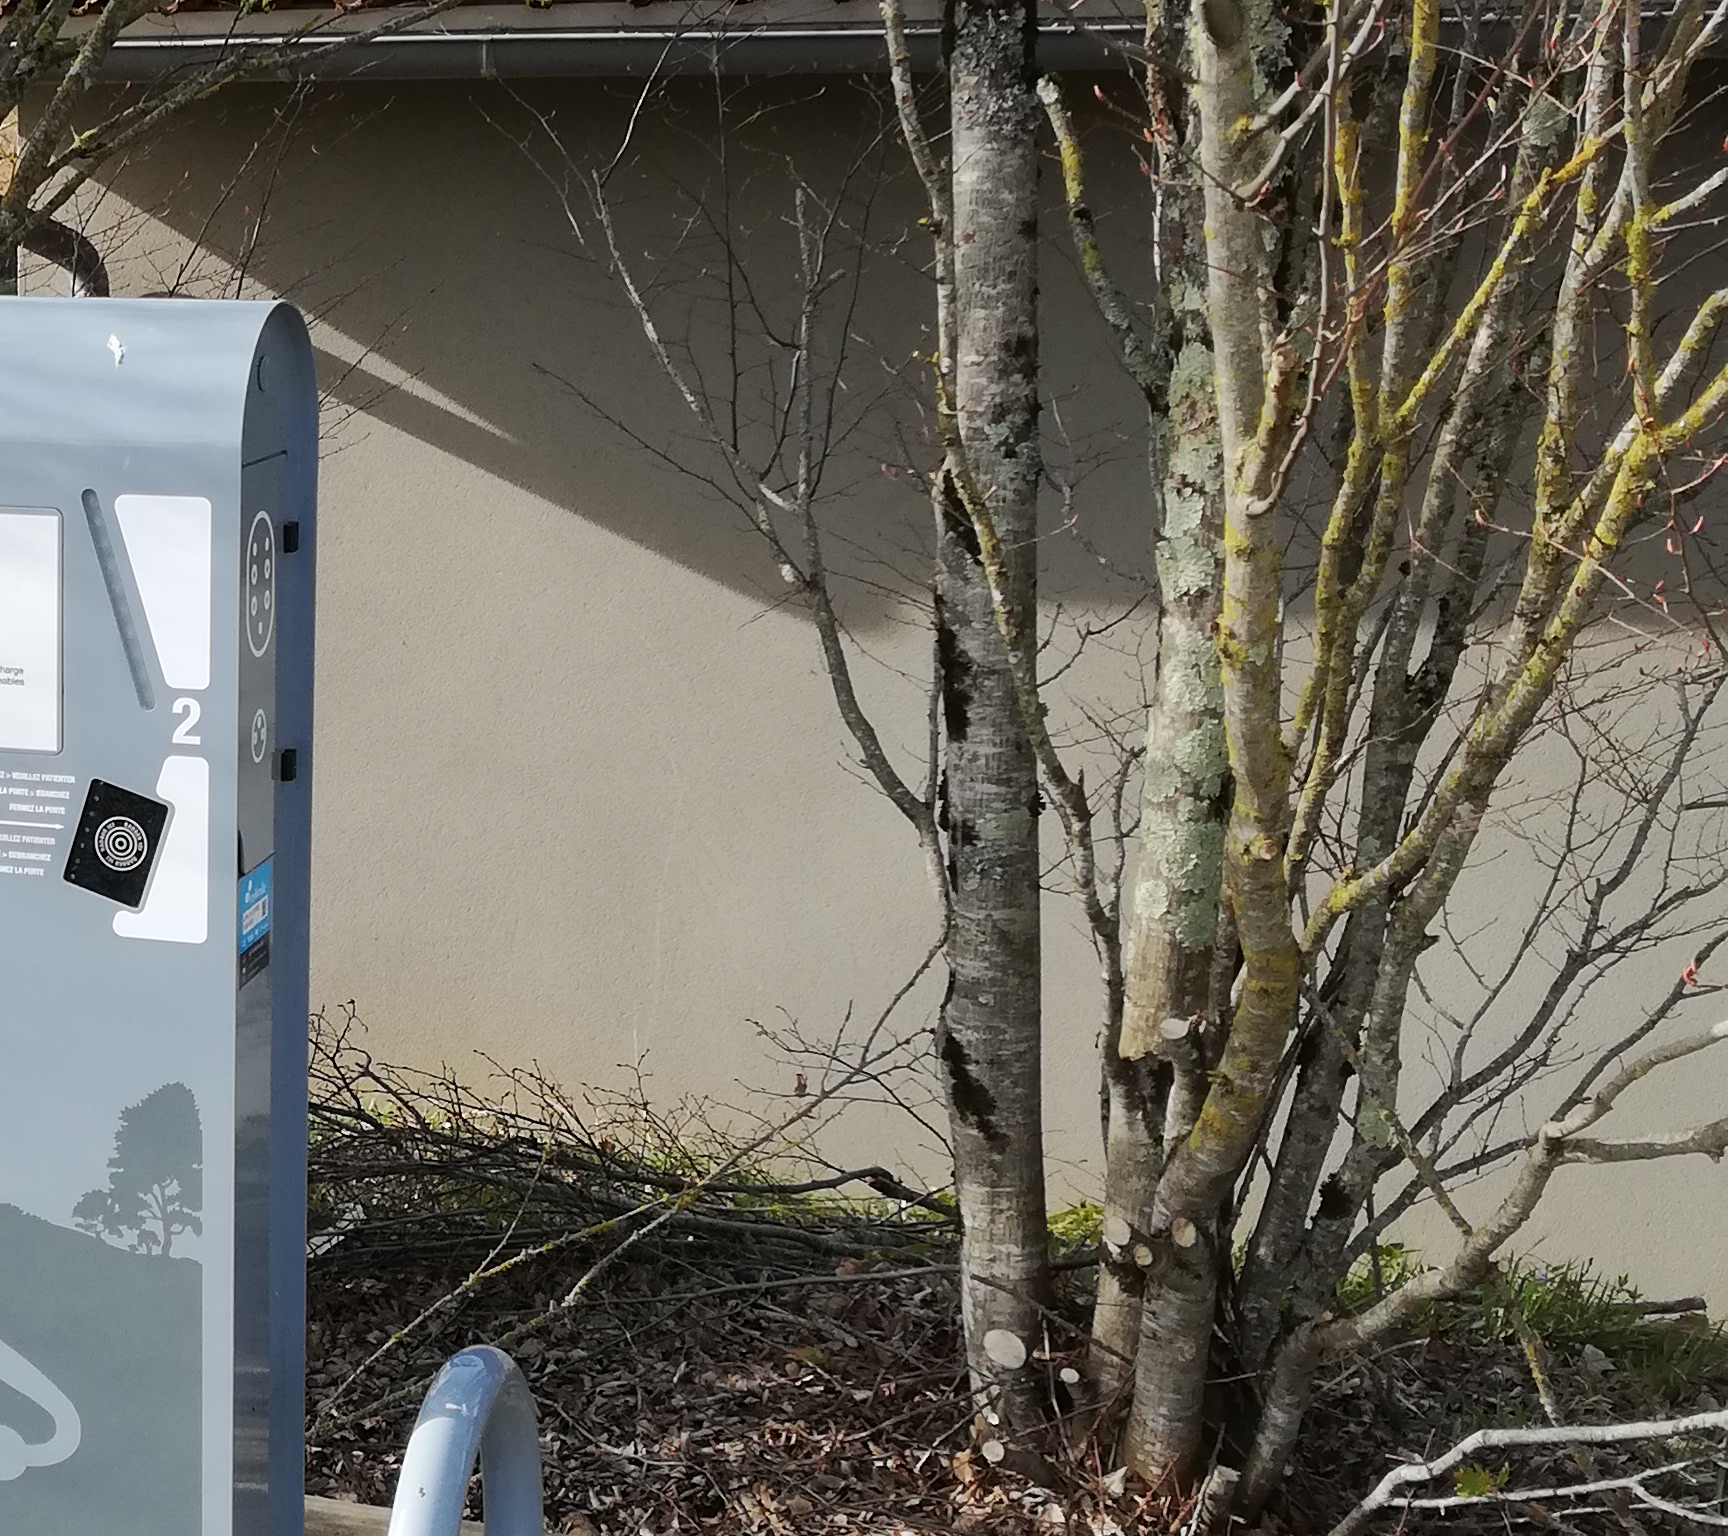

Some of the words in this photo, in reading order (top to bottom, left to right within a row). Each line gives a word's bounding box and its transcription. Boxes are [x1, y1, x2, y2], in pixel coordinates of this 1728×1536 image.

[172, 697, 202, 746] 2
[0, 786, 8, 795] LA
[8, 788, 29, 796] PORTE
[36, 805, 44, 813] LA
[45, 806, 65, 815] PORTE
[14, 866, 23, 874] LA
[24, 868, 44, 876] PORTE
